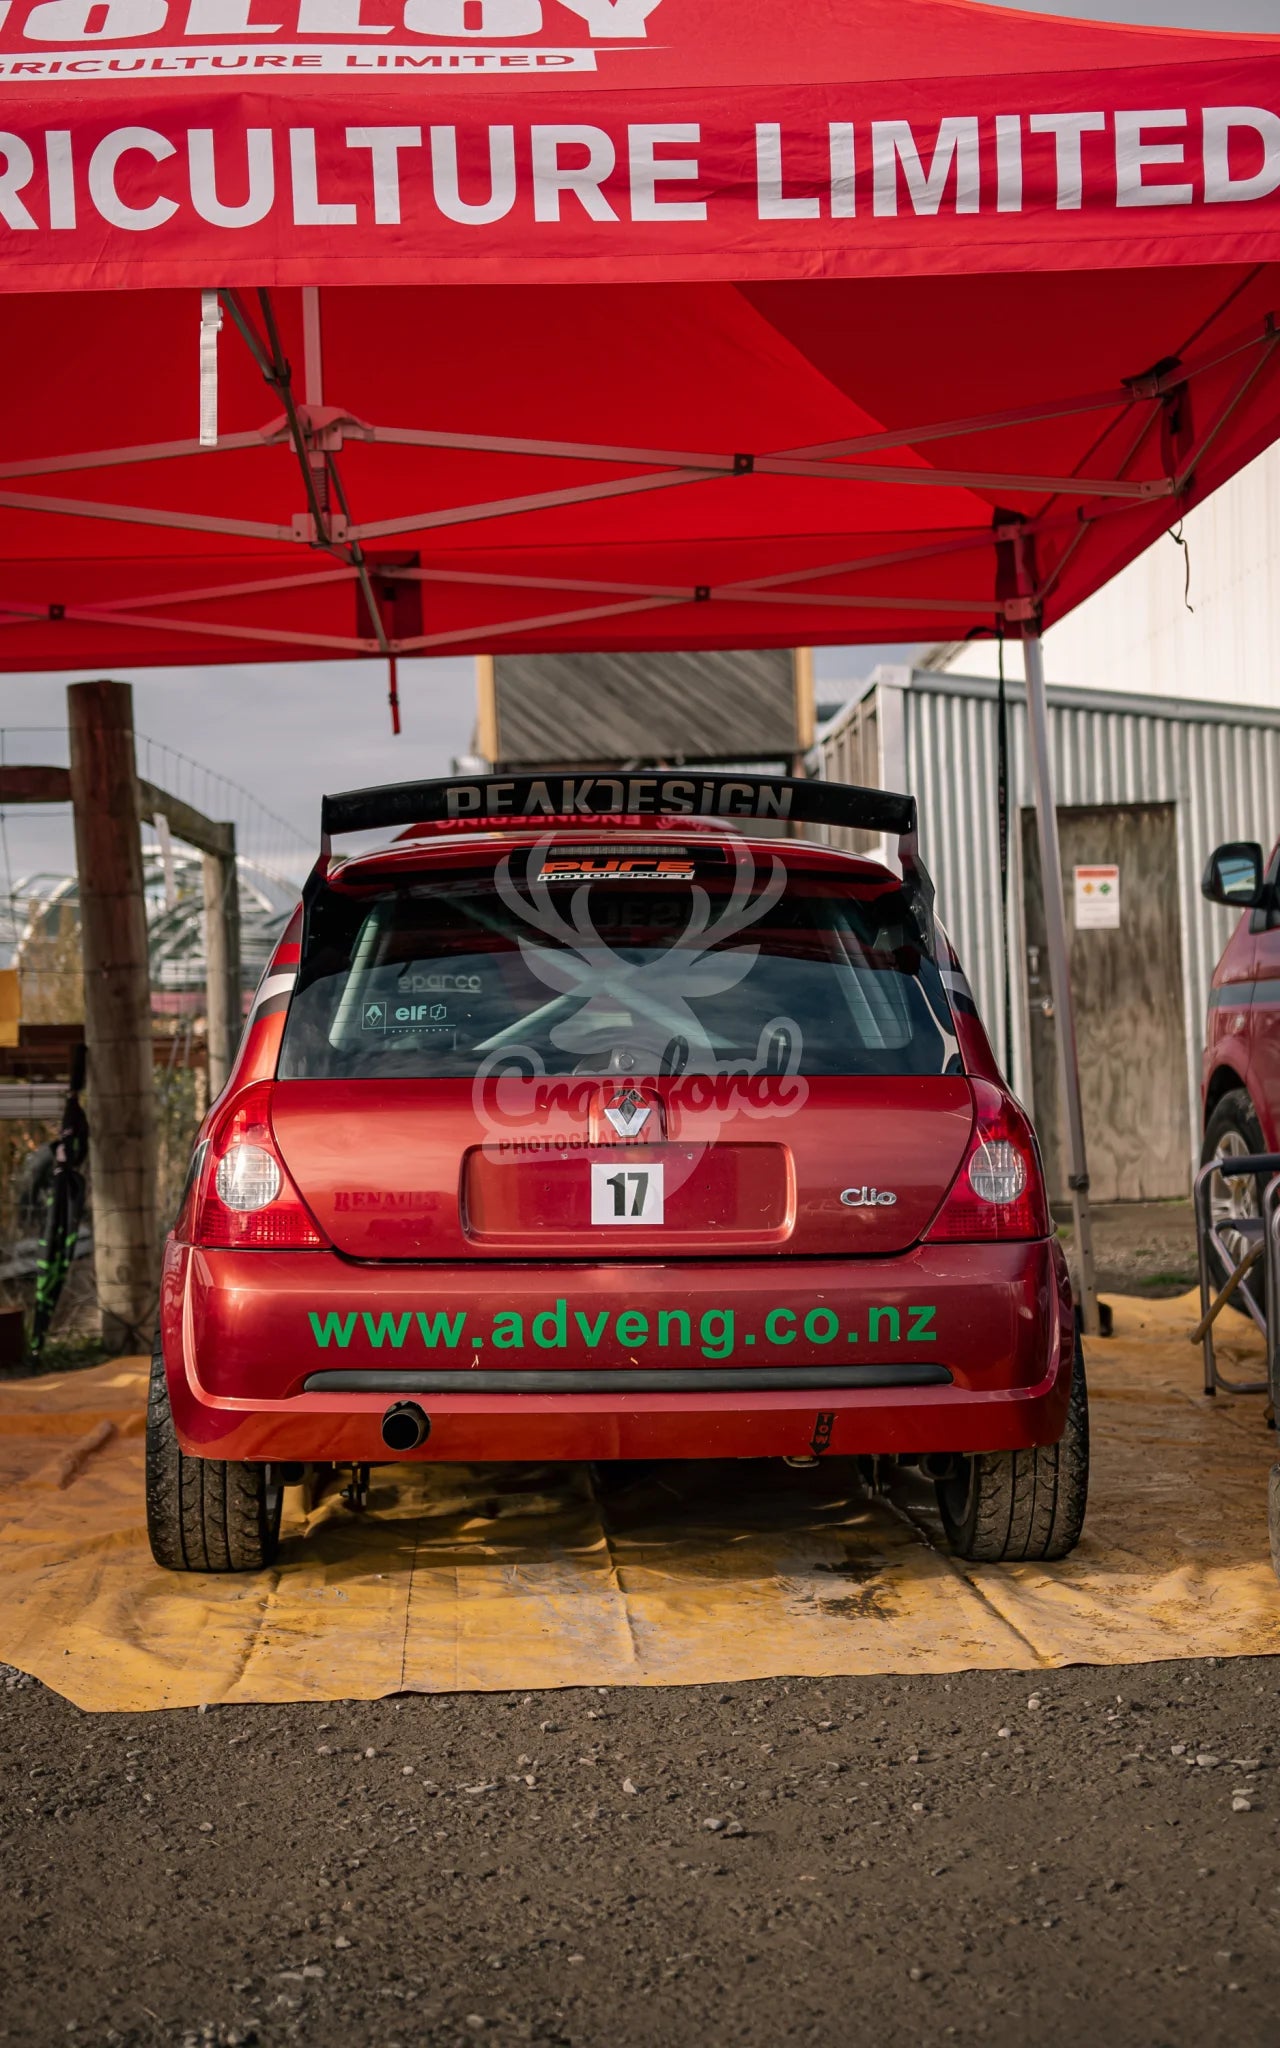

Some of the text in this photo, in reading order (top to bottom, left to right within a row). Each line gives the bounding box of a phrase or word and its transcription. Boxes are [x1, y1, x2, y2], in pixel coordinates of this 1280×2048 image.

[0, 0, 664, 41] OLLOY
[0, 55, 575, 75] RICULTURE LIMITED
[756, 106, 1280, 220] LIMITED
[395, 1005, 427, 1020] elf
[606, 1172, 649, 1217] 17
[840, 1186, 897, 1206] Clio
[308, 1299, 938, 1359] www.adveng.co.nz
